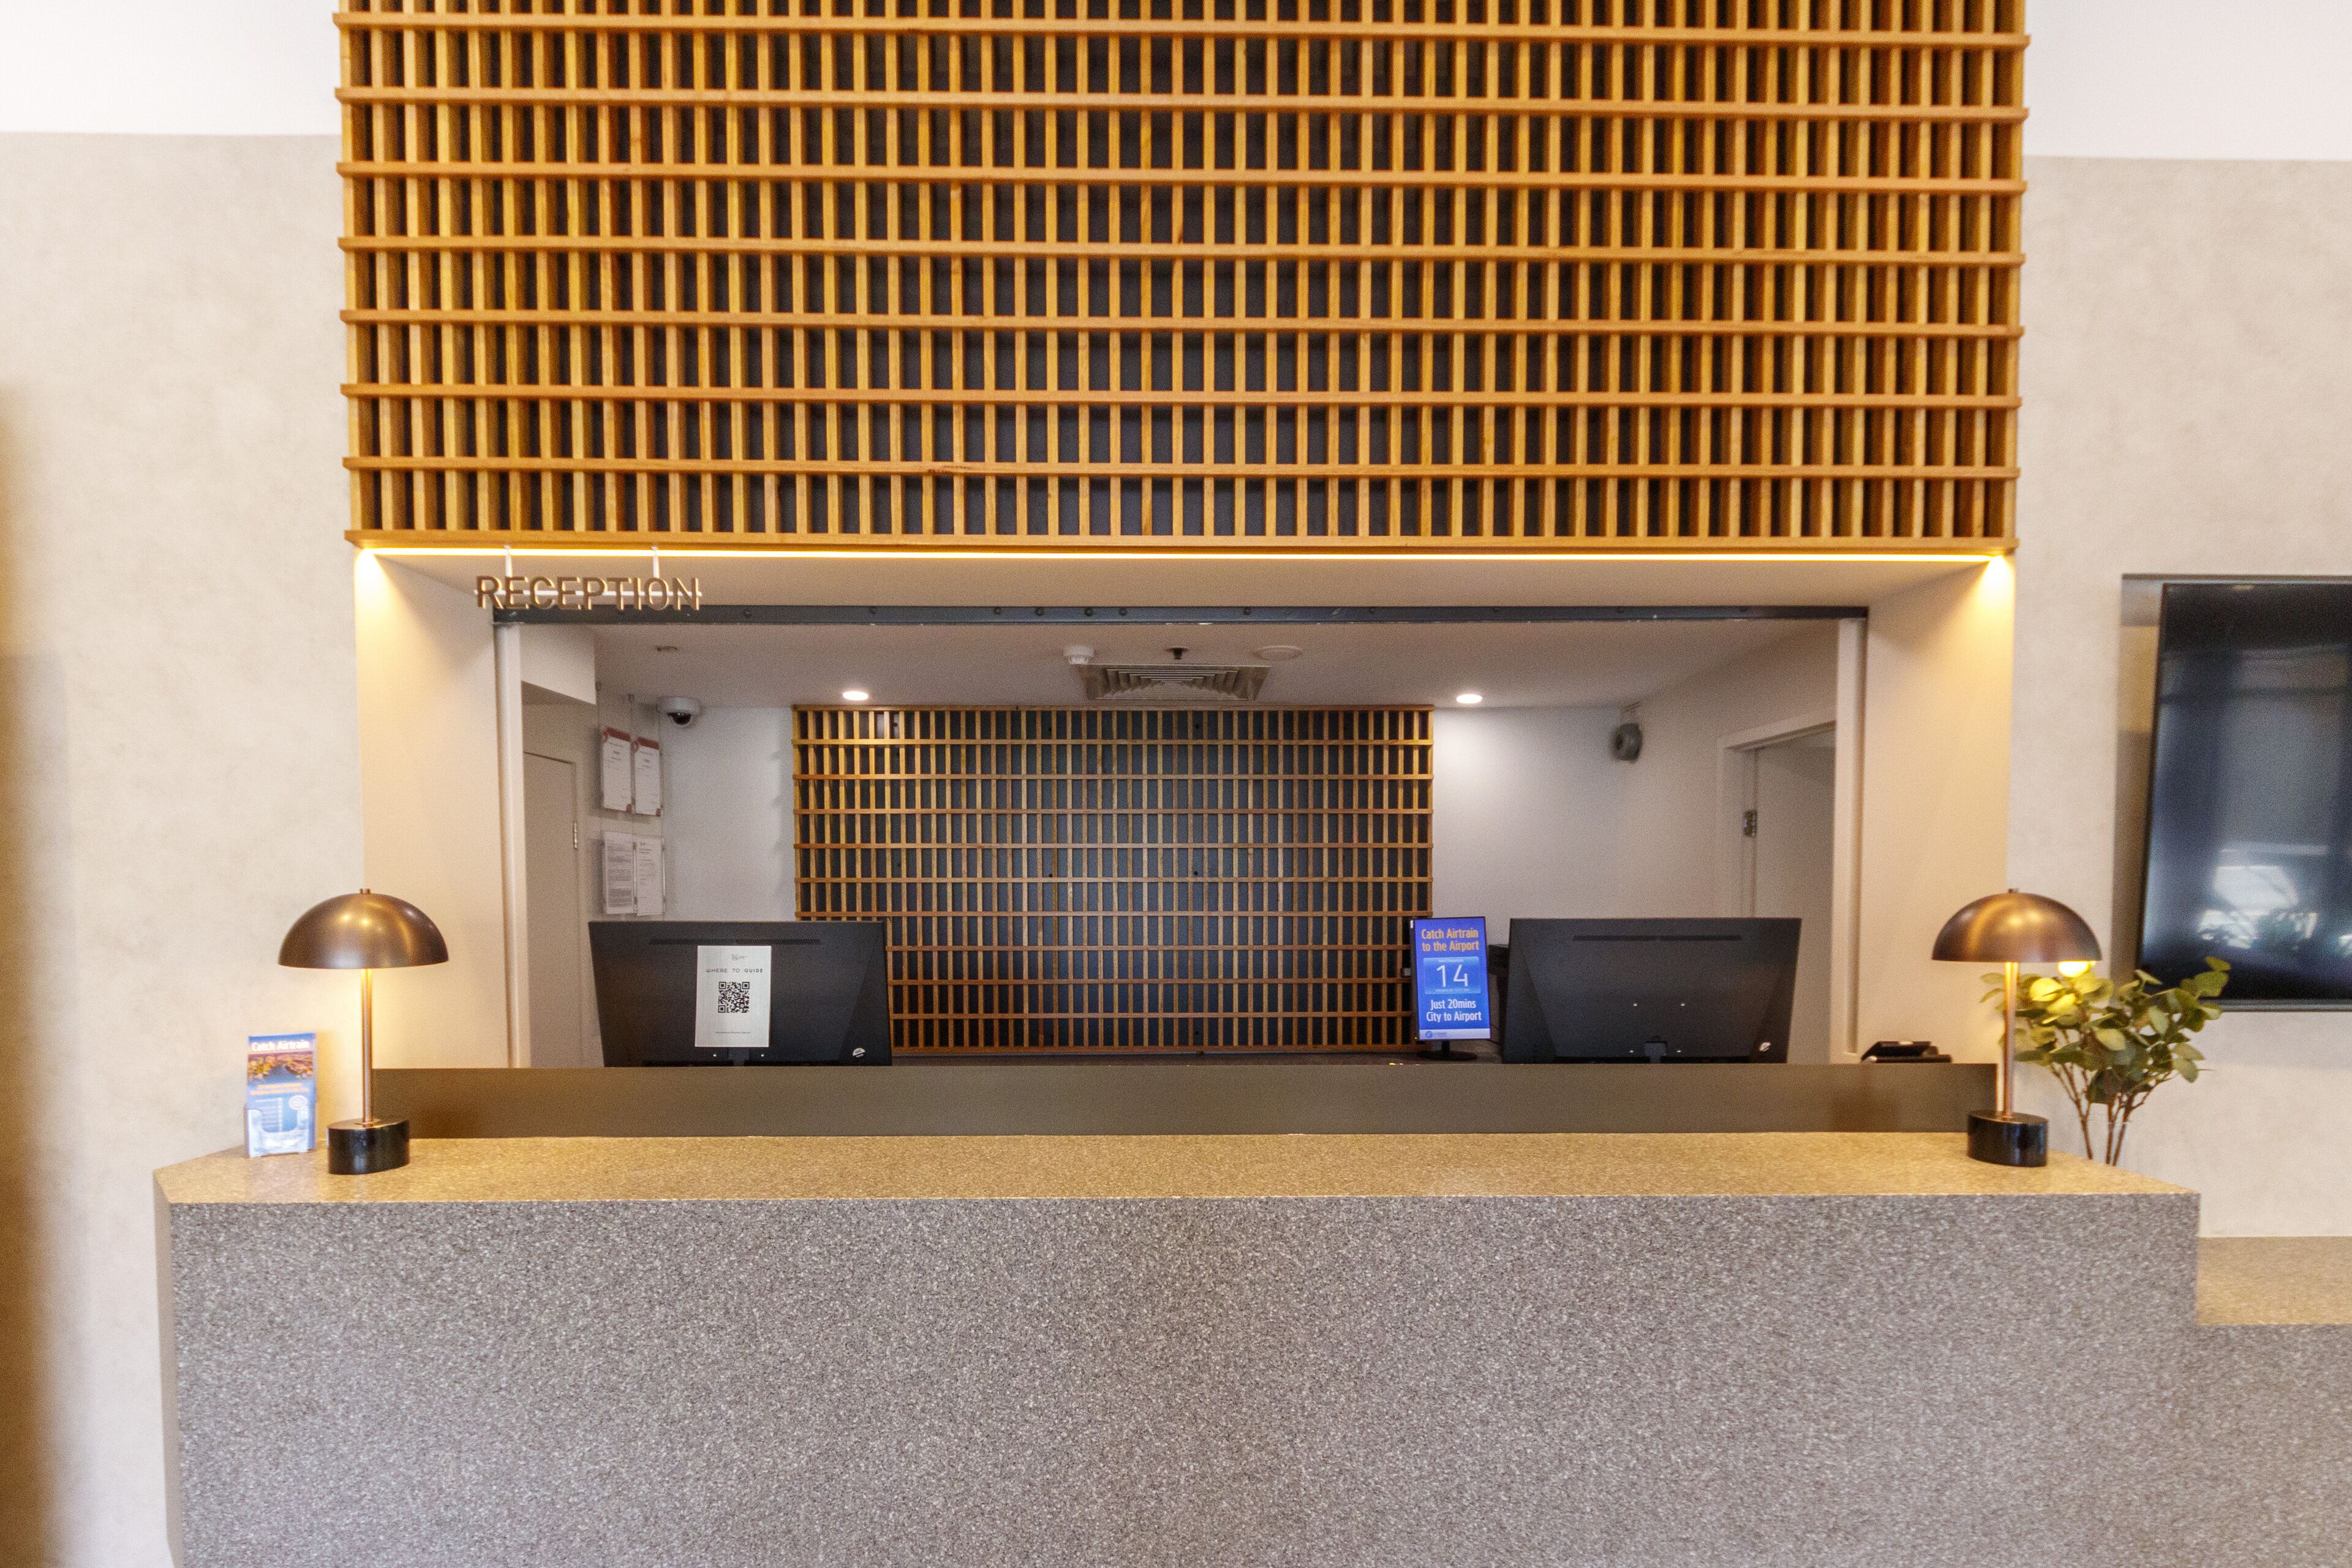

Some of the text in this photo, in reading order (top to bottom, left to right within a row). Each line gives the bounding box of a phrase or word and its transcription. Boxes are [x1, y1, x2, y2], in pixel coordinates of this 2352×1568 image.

[475, 575, 699, 611] RECEPTION
[1422, 928, 1478, 939] Catch Airtrain
[1422, 940, 1479, 952] to the Airport
[1436, 964, 1468, 987] 14
[1430, 998, 1476, 1011] Just 20mins
[1426, 1011, 1482, 1022] City to Airport
[252, 1039, 310, 1052] Catch Airtrain
